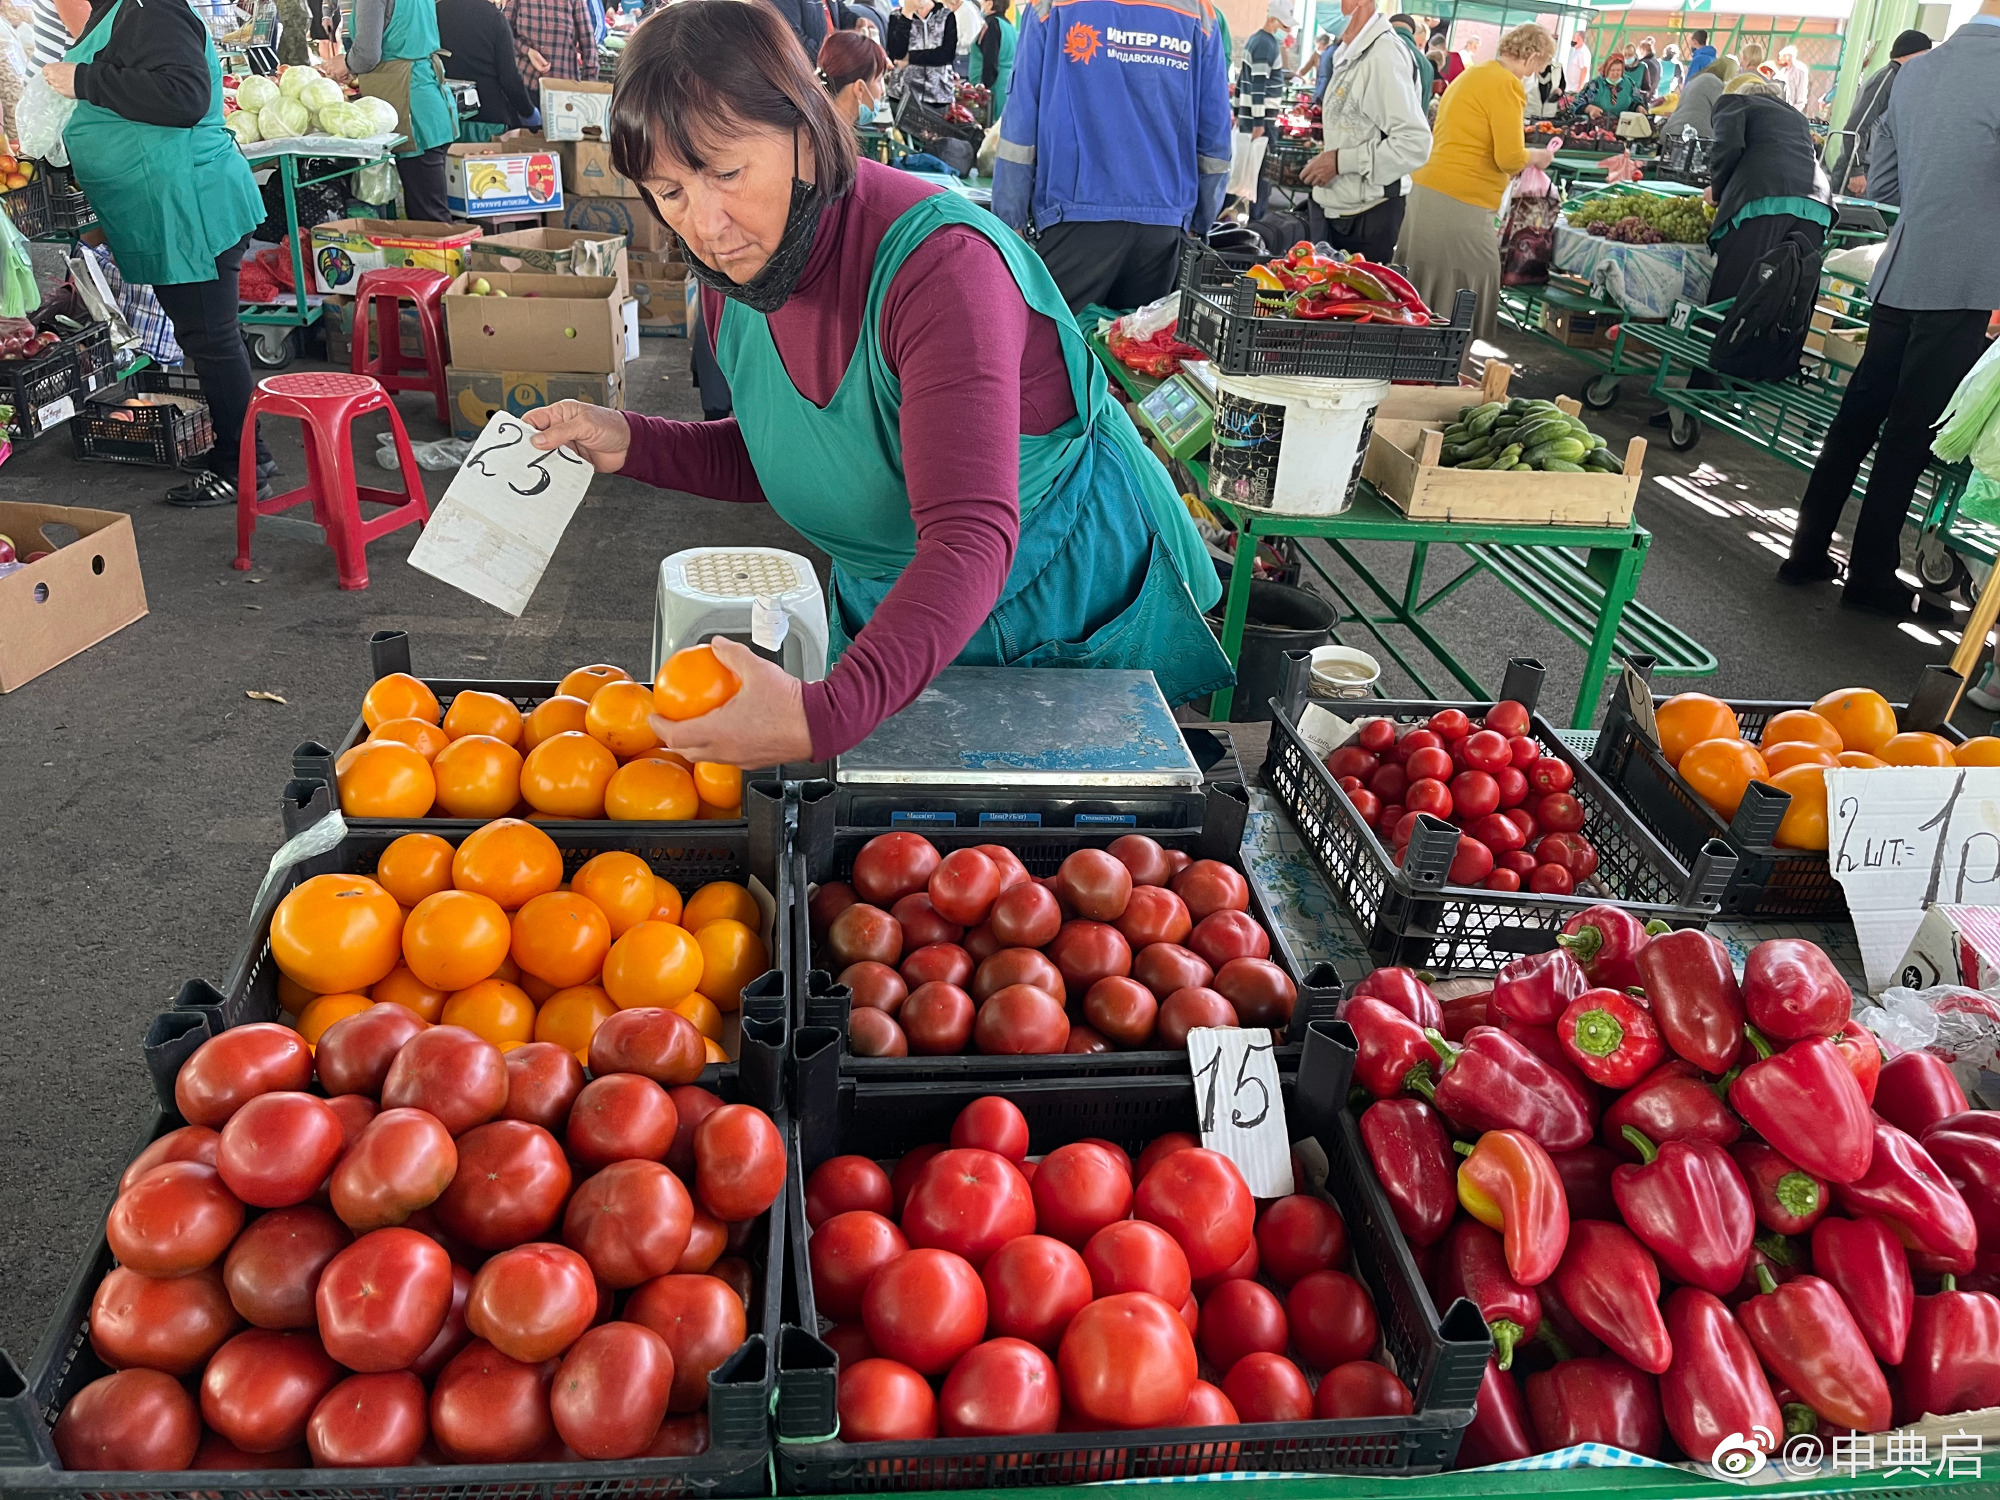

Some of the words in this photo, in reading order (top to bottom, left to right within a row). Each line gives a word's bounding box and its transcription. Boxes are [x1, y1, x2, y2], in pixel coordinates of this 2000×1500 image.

[1107, 27, 1158, 46] ИНТЕР
[1160, 35, 1192, 54] РАО
[1107, 49, 1165, 65] МЛДАВСКАЯ
[1166, 59, 1189, 71] ГРЭС
[472, 199, 502, 209] BANANAS
[1672, 308, 1686, 326] 97
[1193, 1045, 1273, 1132] 15
